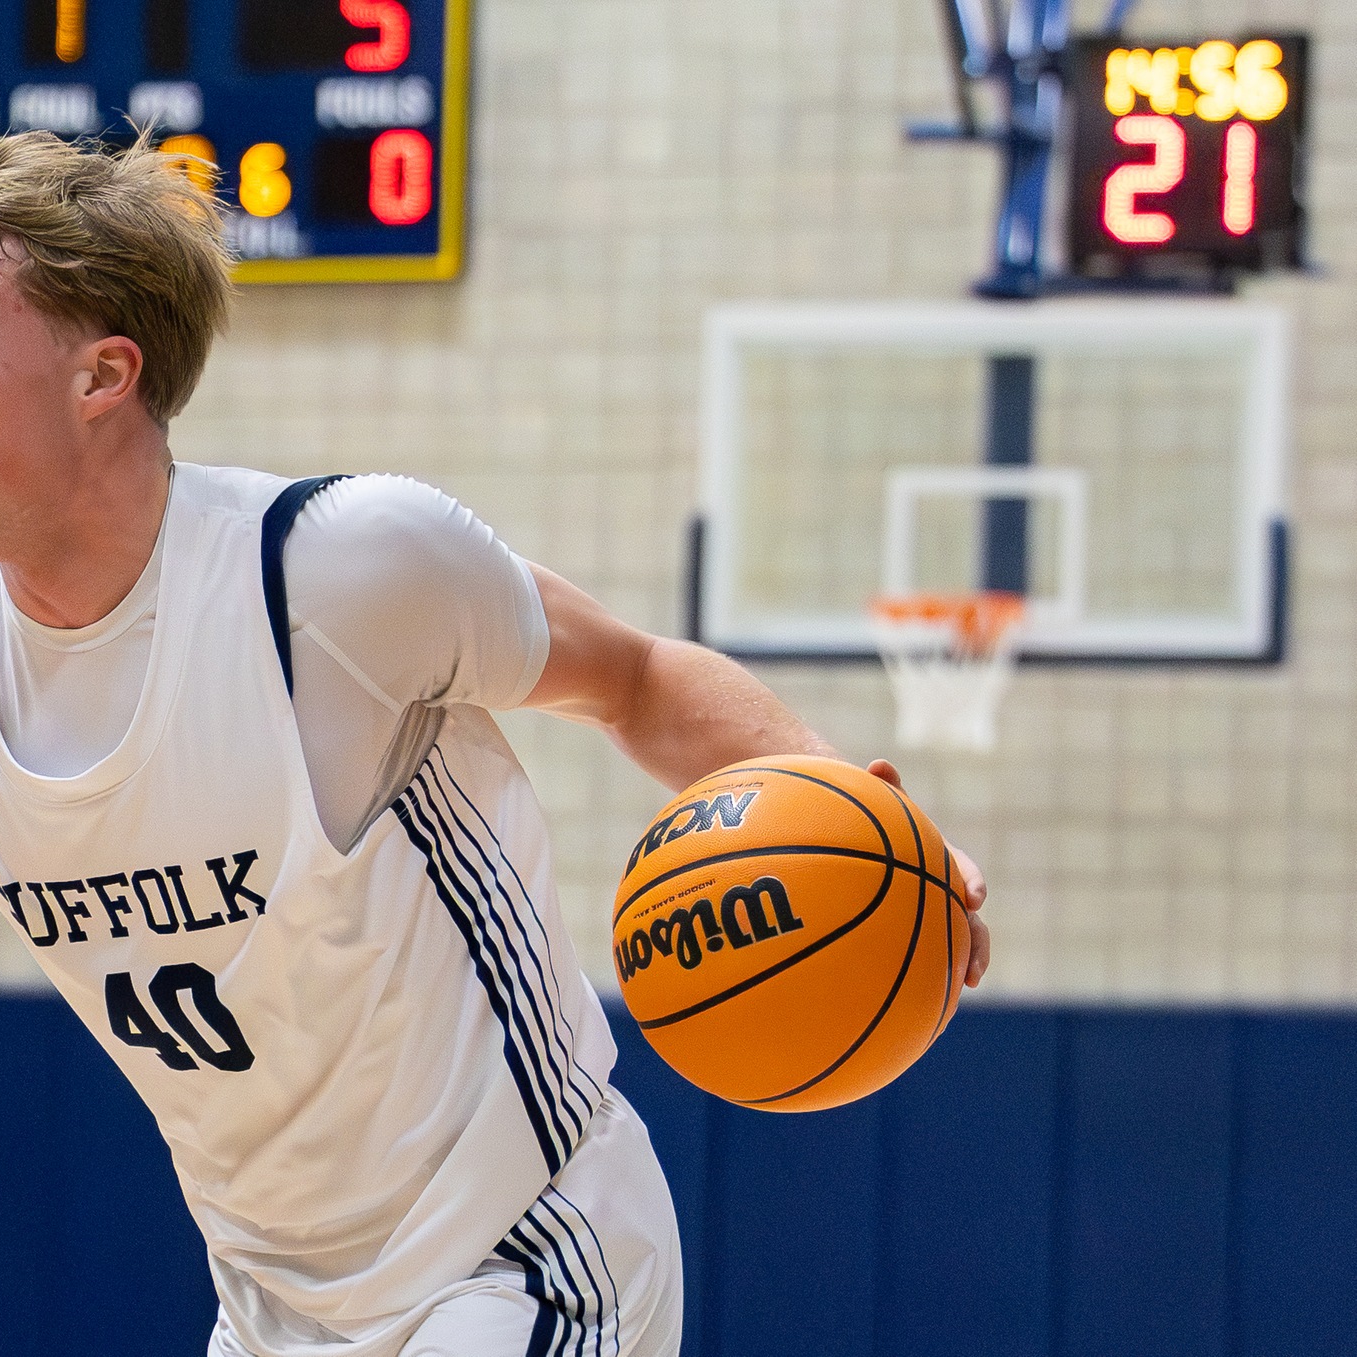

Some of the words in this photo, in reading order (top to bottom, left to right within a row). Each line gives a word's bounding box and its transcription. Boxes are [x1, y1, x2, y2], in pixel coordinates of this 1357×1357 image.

[239, 142, 291, 217] 6
[369, 129, 433, 225] 0
[1103, 115, 1258, 243] 21
[615, 876, 805, 983] Wilson
[104, 962, 255, 1072] 40
